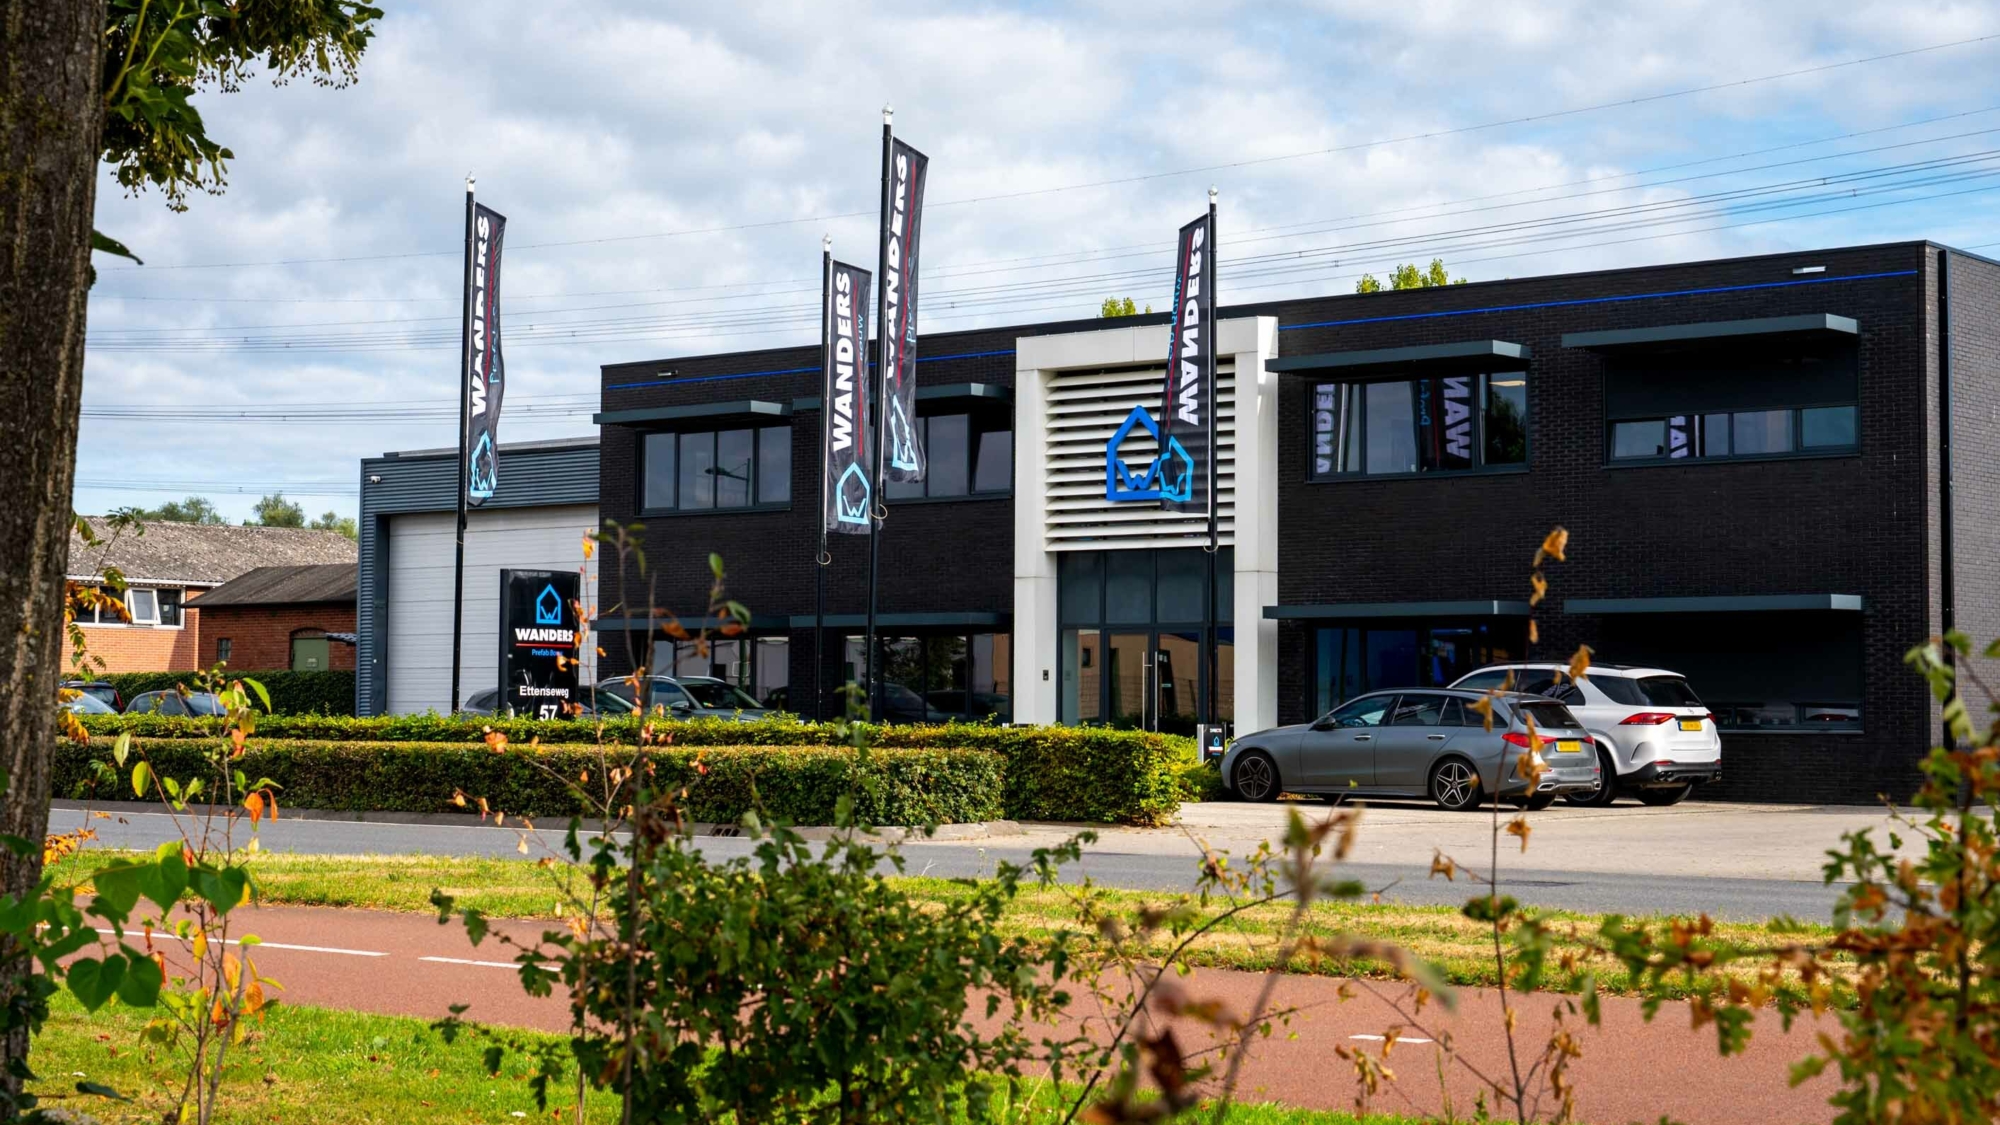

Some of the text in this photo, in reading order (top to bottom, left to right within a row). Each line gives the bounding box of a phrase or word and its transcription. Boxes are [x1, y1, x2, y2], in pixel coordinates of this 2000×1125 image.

[472, 215, 490, 418] WANDERS
[833, 271, 853, 451] WANDERS
[514, 628, 574, 642] WANDERS
[519, 685, 570, 698] Ettenseweg
[539, 705, 558, 721] 57
